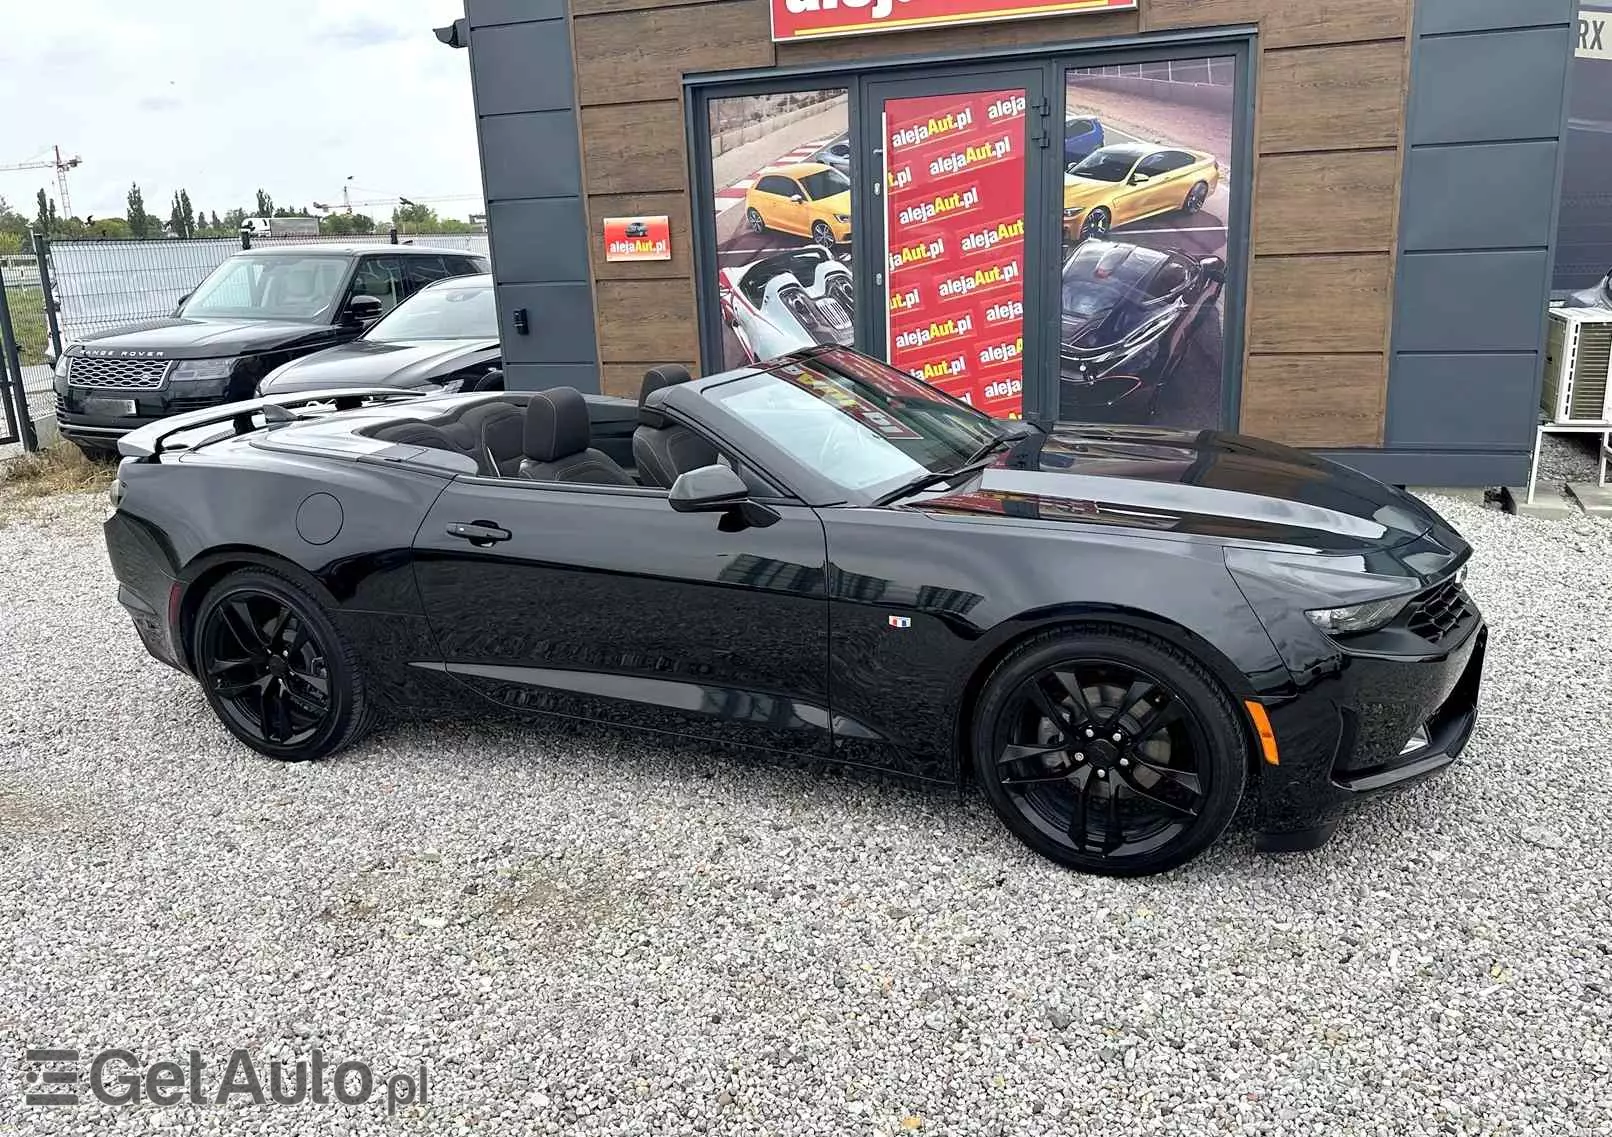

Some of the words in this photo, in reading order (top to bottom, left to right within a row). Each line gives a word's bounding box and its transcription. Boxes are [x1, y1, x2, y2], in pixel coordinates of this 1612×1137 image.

[987, 96, 1025, 119] aleja
[891, 108, 973, 147] alejaAut.pl
[929, 136, 1011, 175] alejaAut.pl
[899, 187, 979, 224] alejaAut.pl
[609, 240, 666, 254] alejaAut.pl
[939, 261, 1018, 297] alejaAut.pl
[896, 315, 972, 348] alejaAut.pl
